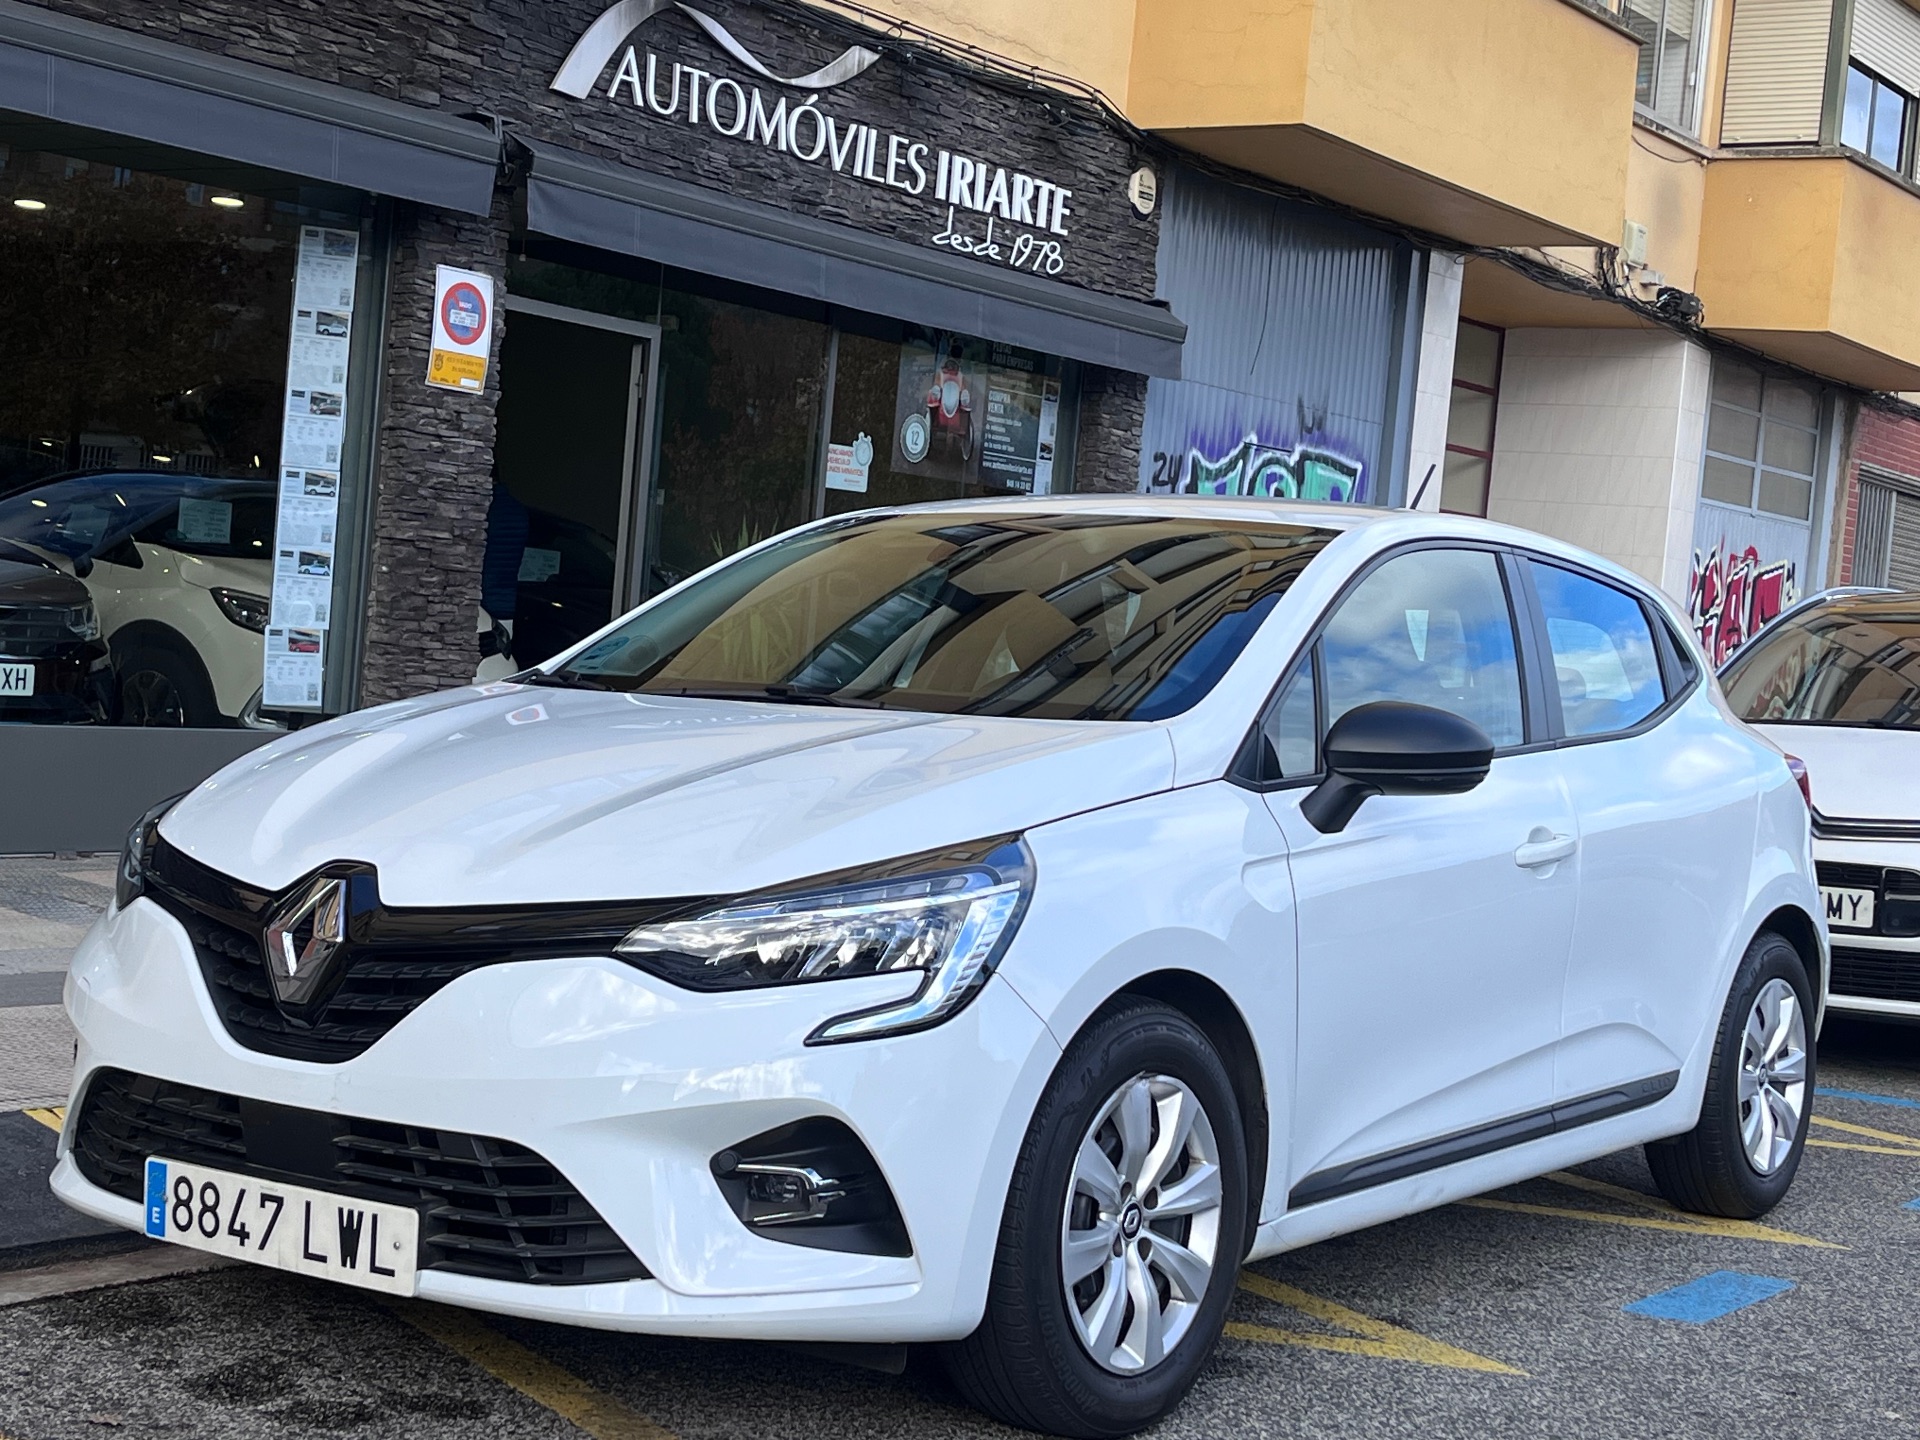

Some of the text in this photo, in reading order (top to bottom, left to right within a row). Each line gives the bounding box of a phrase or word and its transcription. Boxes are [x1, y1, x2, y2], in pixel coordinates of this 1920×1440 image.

[607, 44, 1073, 237] AUTOMÓVILES IRIARTE
[932, 205, 1066, 275] desde 1978
[1, 667, 28, 691] XH
[1819, 891, 1864, 921] MY
[1641, 1076, 1672, 1094] CLIO
[151, 1175, 396, 1278] E 8847 LWL
